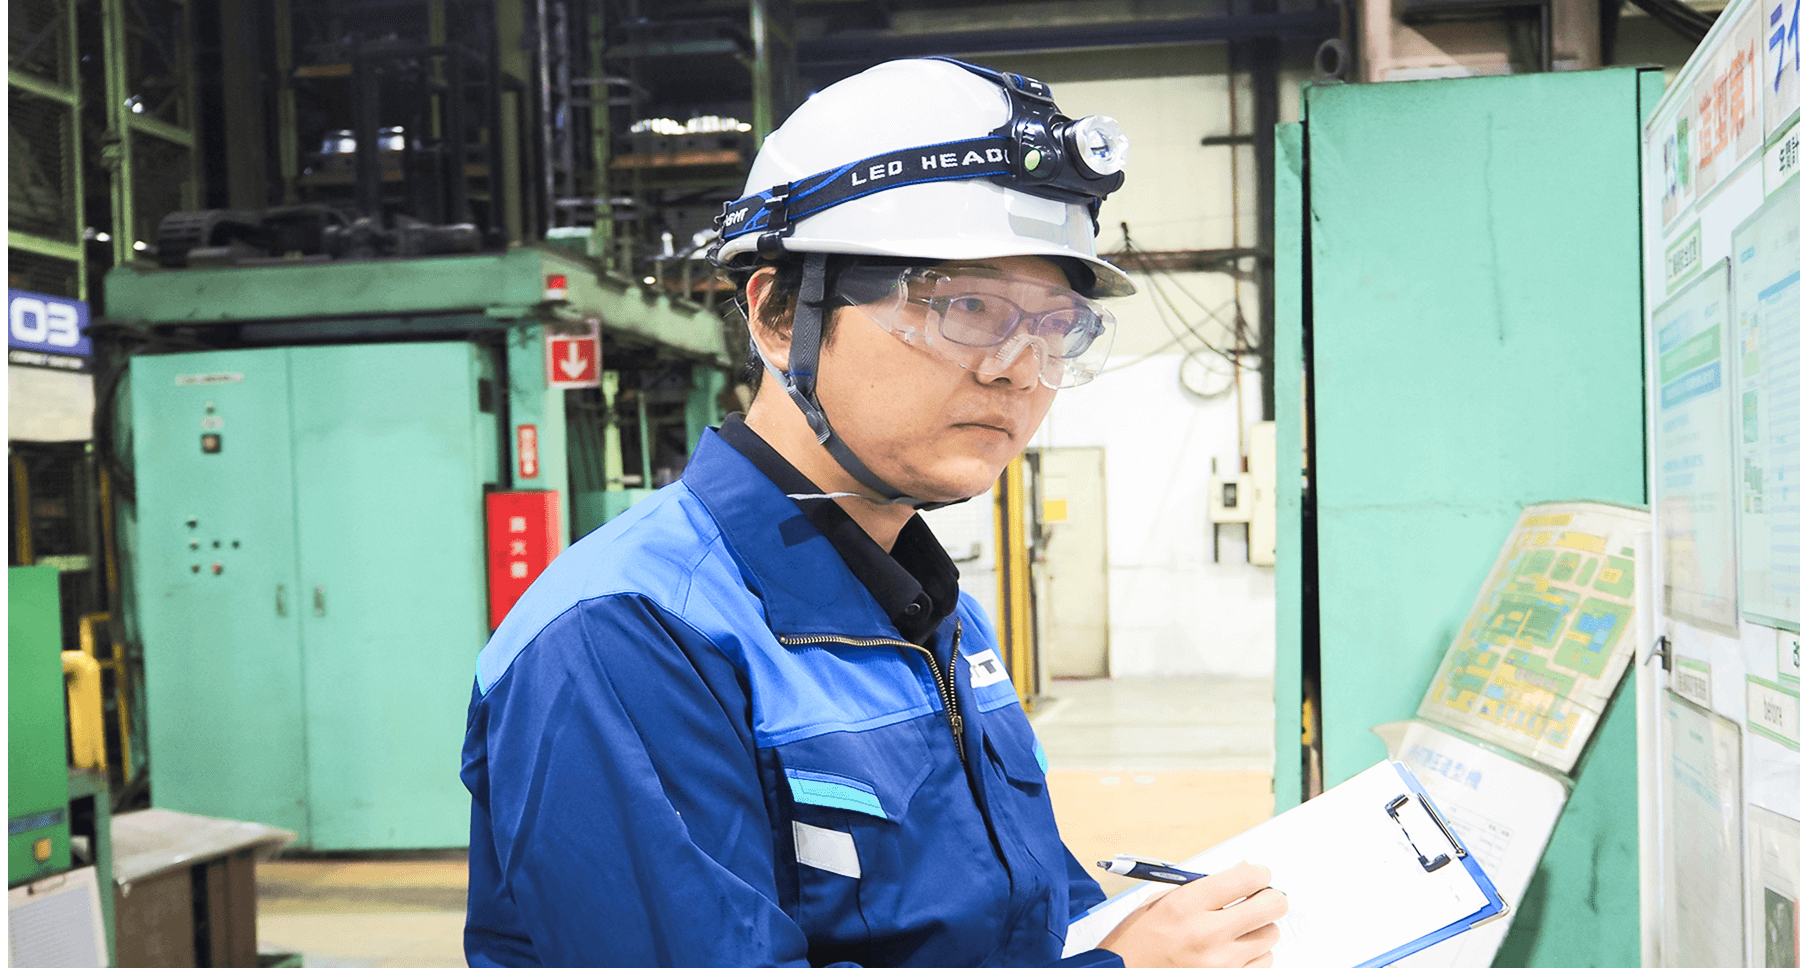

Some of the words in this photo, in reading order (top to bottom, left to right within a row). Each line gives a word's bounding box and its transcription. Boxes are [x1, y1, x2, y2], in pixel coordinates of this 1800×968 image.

[851, 160, 903, 186] LED
[921, 148, 1010, 170] HEAD
[9, 297, 79, 347] 03
